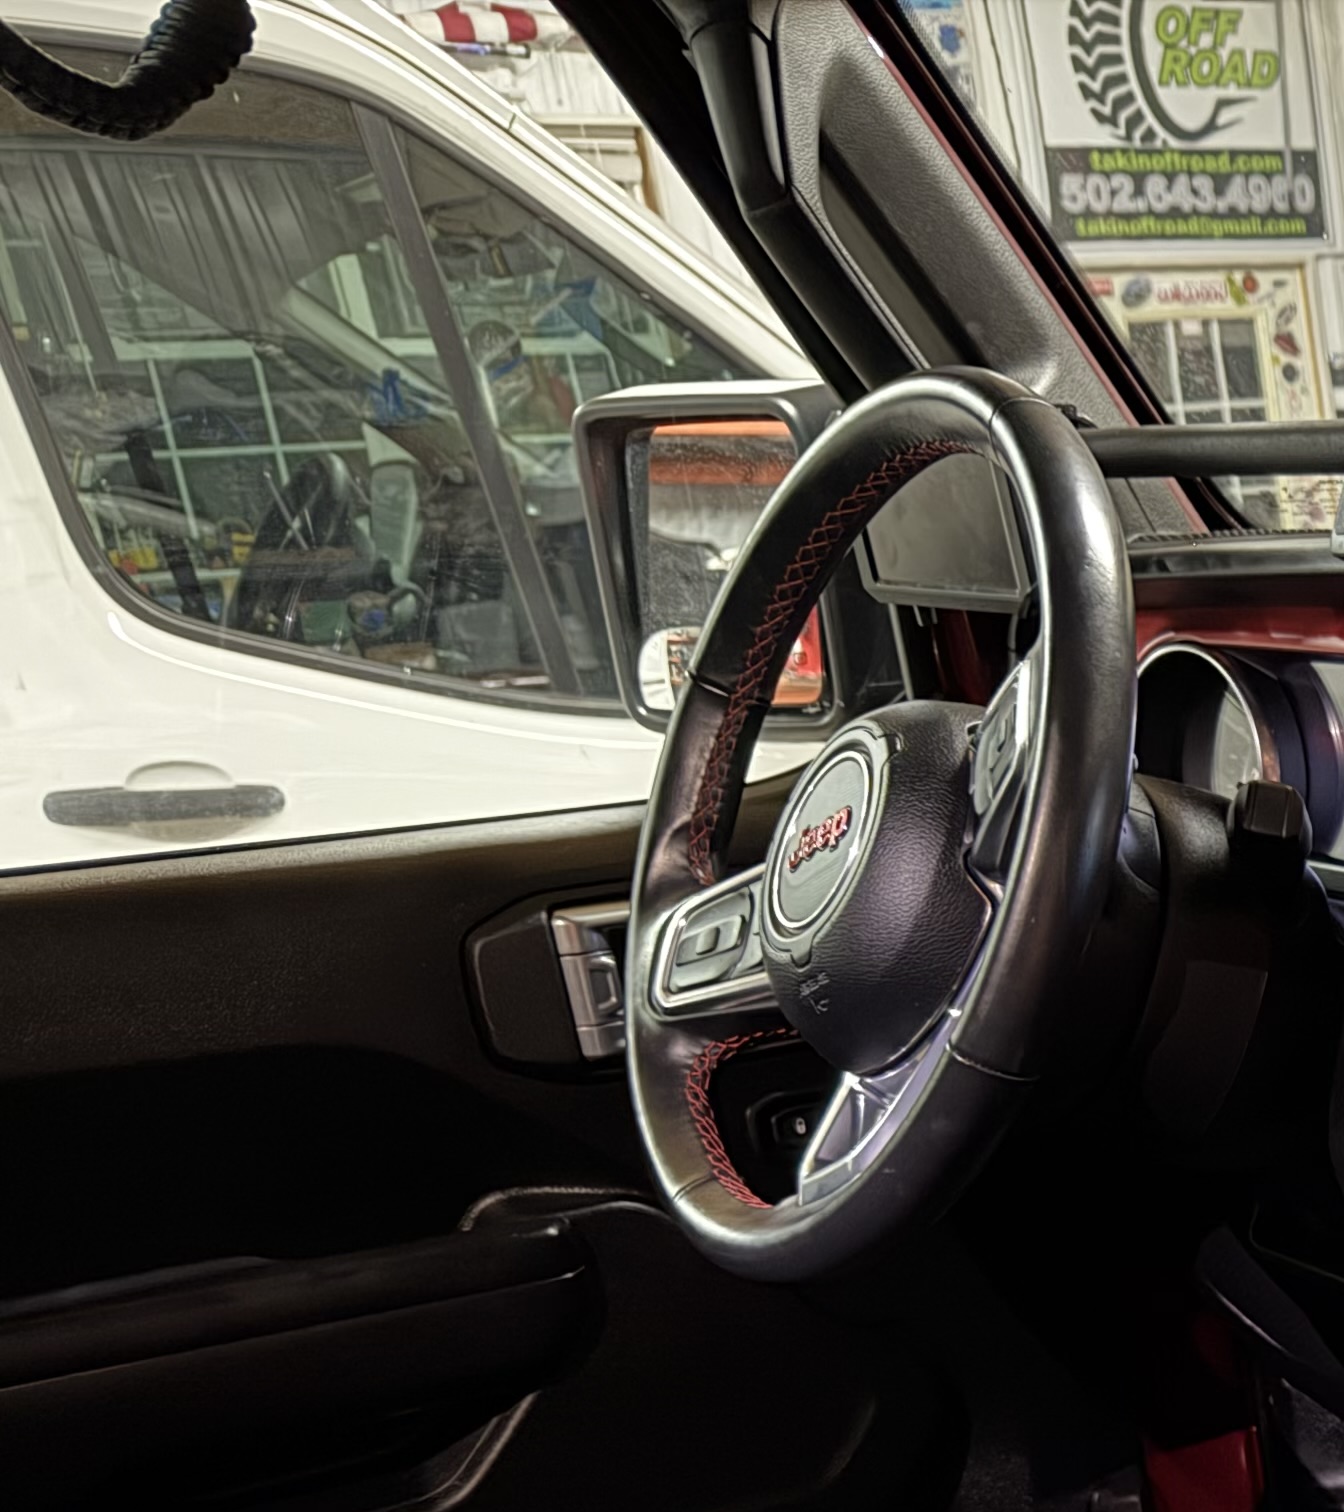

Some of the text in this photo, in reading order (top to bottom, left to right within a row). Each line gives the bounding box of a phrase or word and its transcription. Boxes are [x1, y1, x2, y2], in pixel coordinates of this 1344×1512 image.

[1155, 5, 1243, 49] OFF
[1157, 47, 1280, 90] ROAD
[786, 805, 853, 873] Jeep
